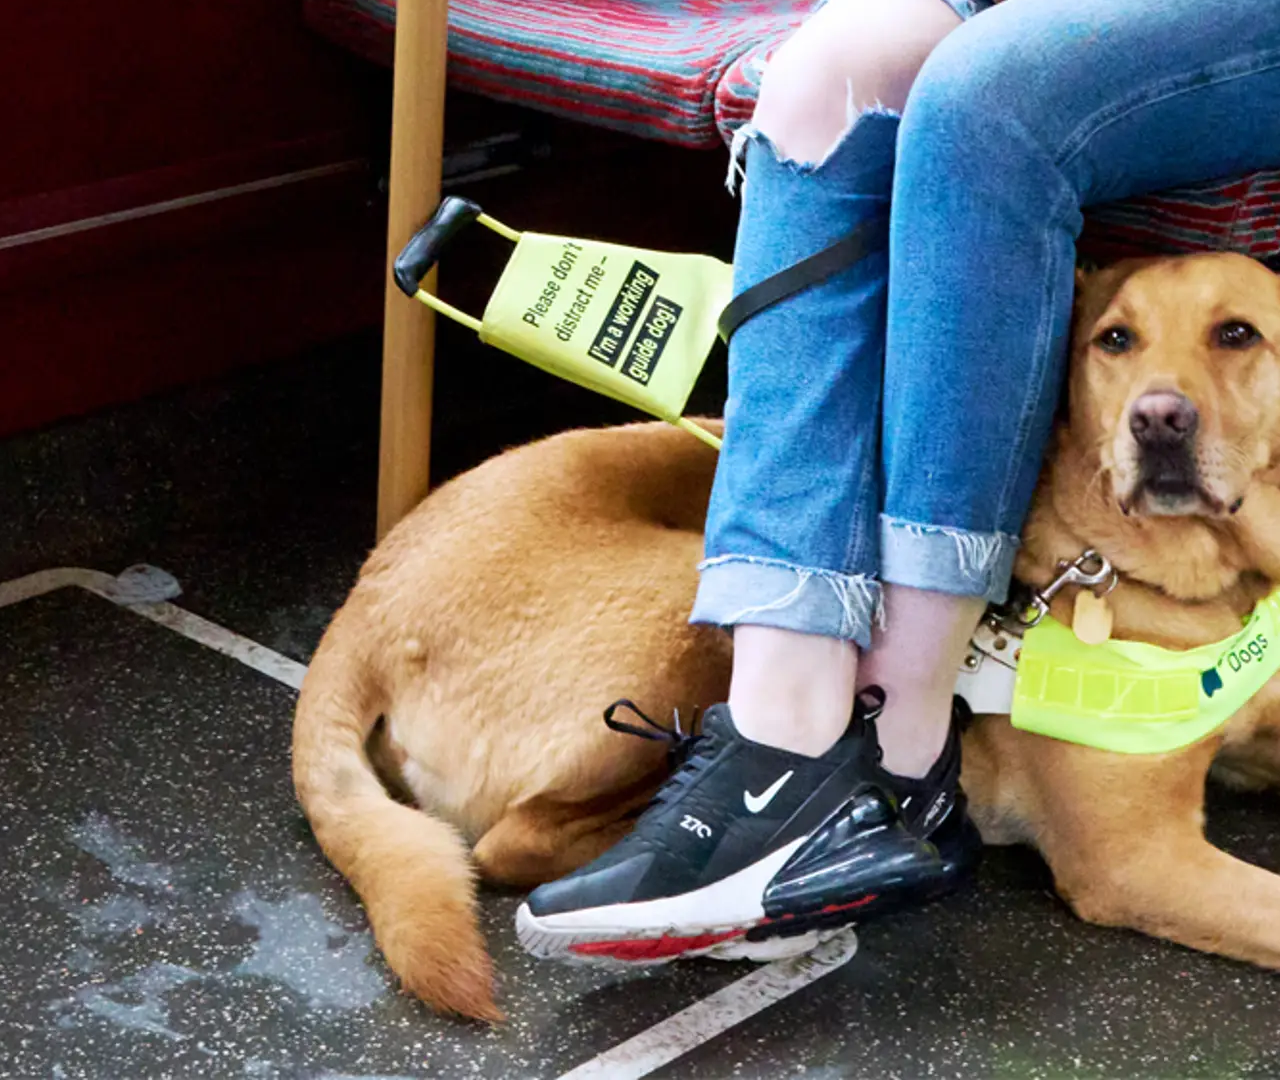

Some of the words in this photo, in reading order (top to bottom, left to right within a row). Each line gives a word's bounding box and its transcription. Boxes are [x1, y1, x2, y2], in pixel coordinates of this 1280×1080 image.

[522, 280, 561, 328] Please
[551, 242, 583, 281] don't
[554, 288, 593, 342] distract
[584, 265, 605, 291] me
[612, 270, 655, 326] working
[591, 333, 619, 362] I'm
[607, 324, 623, 336] a
[628, 338, 658, 382] guide
[645, 301, 676, 338] dog!
[1227, 633, 1269, 673] Dogs
